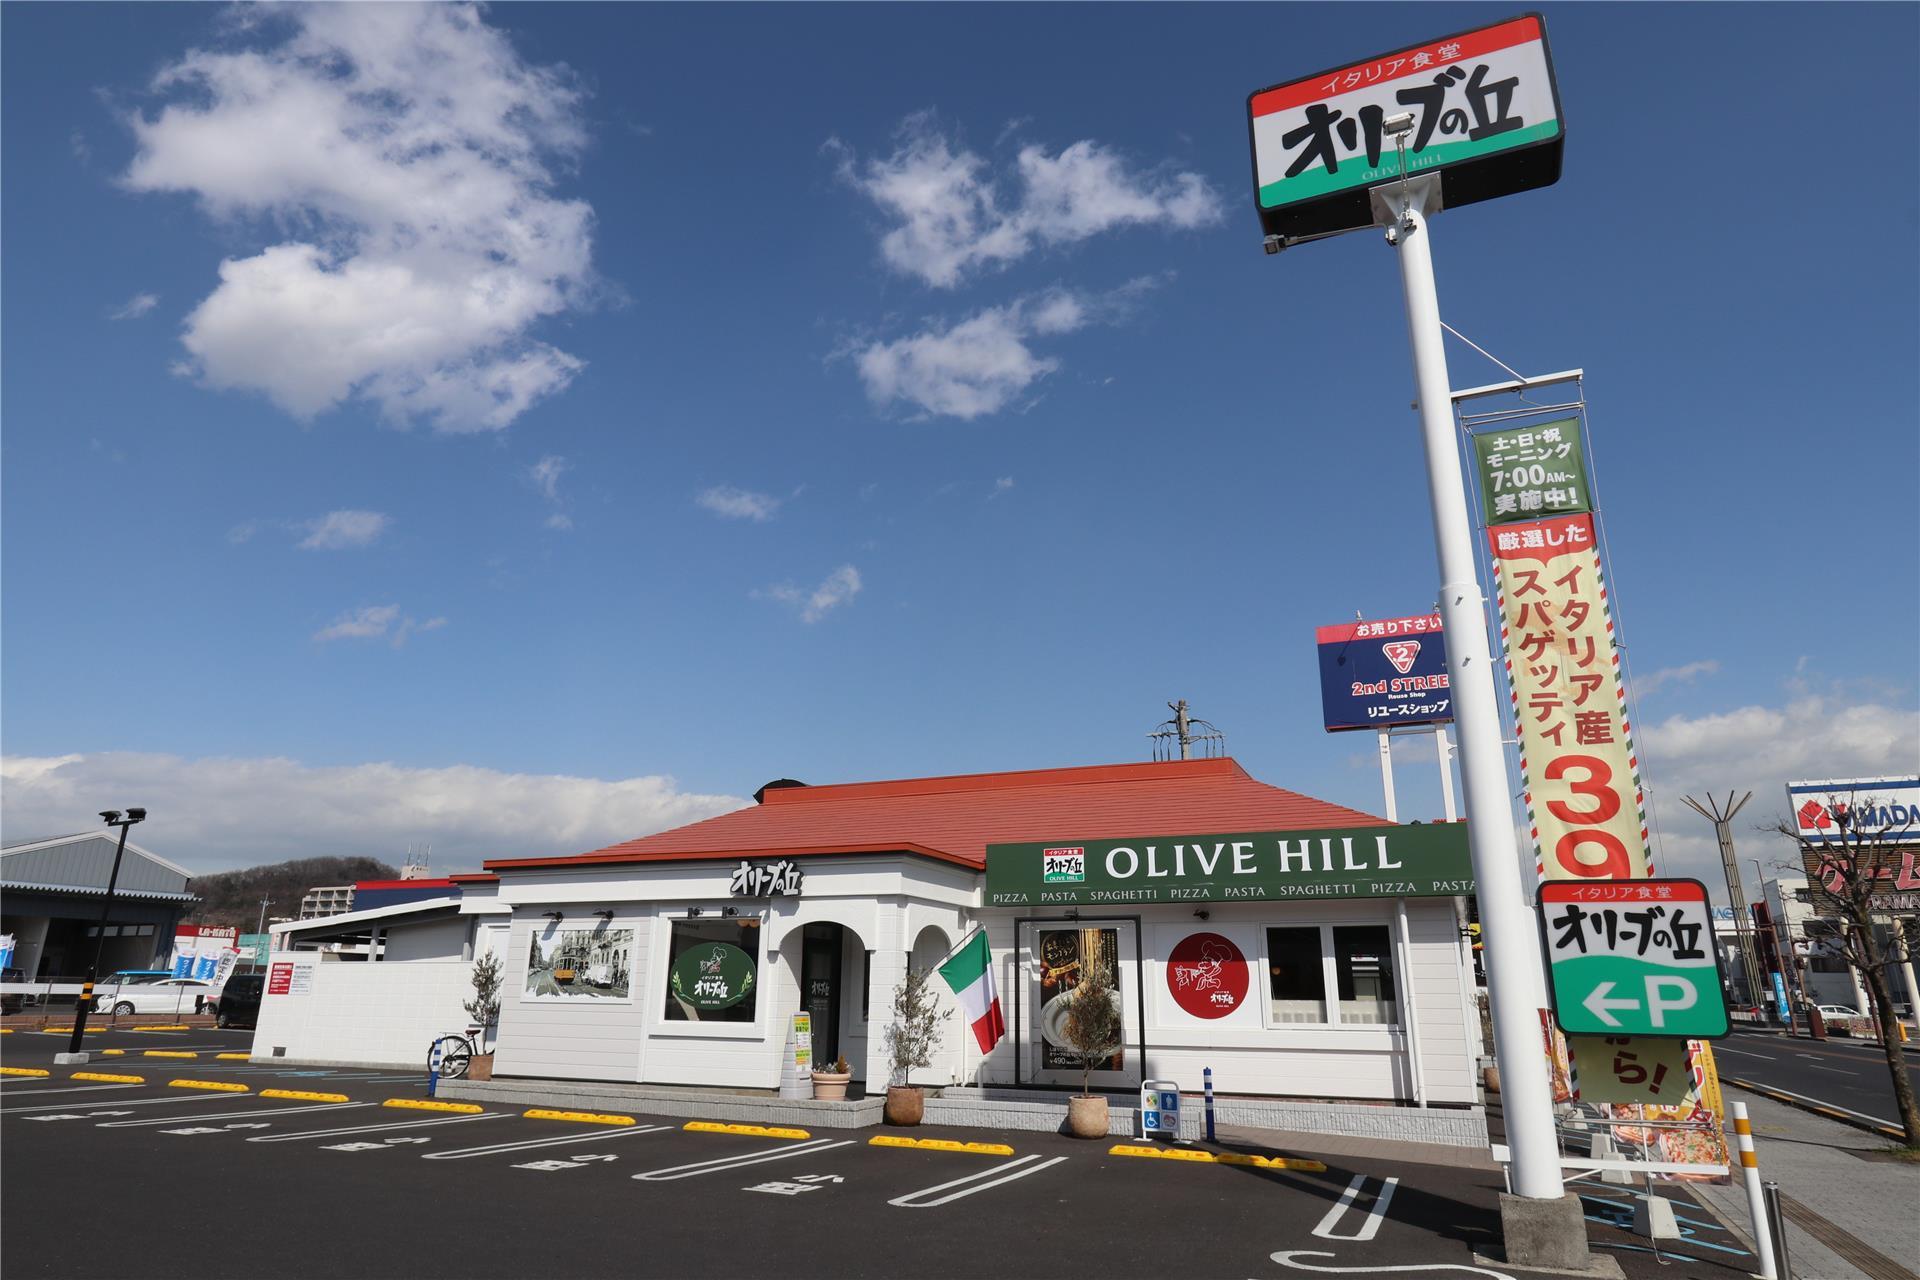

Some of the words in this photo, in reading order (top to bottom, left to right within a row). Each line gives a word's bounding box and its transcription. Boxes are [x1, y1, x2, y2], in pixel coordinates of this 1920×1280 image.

[1321, 42, 1462, 94] イタリア食堂
[1281, 65, 1524, 178] オリブの丘
[1362, 163, 1404, 180] OLIV
[1493, 427, 1562, 452] 土・日・祝
[1486, 442, 1573, 468] モーニング
[1495, 487, 1579, 516] 実施中!
[1498, 524, 1588, 551] 厳選した
[1357, 617, 1443, 637] お売り下さい
[1512, 570, 1567, 747] スパゲッティ
[1553, 565, 1615, 746] イタリア産
[1352, 680, 1387, 696] 2nd
[1390, 674, 1450, 692] STREE
[1368, 699, 1449, 718] リユースショップ
[1046, 857, 1083, 873] オリーブの丘
[1105, 842, 1257, 879] OLIVE
[1277, 836, 1402, 873] HILL
[731, 860, 800, 896] オリーブの丘
[993, 893, 1028, 903] PIZZA
[1041, 891, 1077, 901] PASTA
[1090, 889, 1157, 900] SPAGHETTI
[1170, 888, 1210, 898] PIZZA
[1225, 886, 1266, 897] PASTA
[1280, 884, 1356, 895] SPAGHETTI
[1371, 882, 1416, 893] PIZZA
[1571, 885, 1673, 900] イタリア食堂
[1553, 904, 1705, 960] オリーブの丘
[694, 980, 728, 998] オリーブの丘
[1644, 975, 1698, 1028] P
